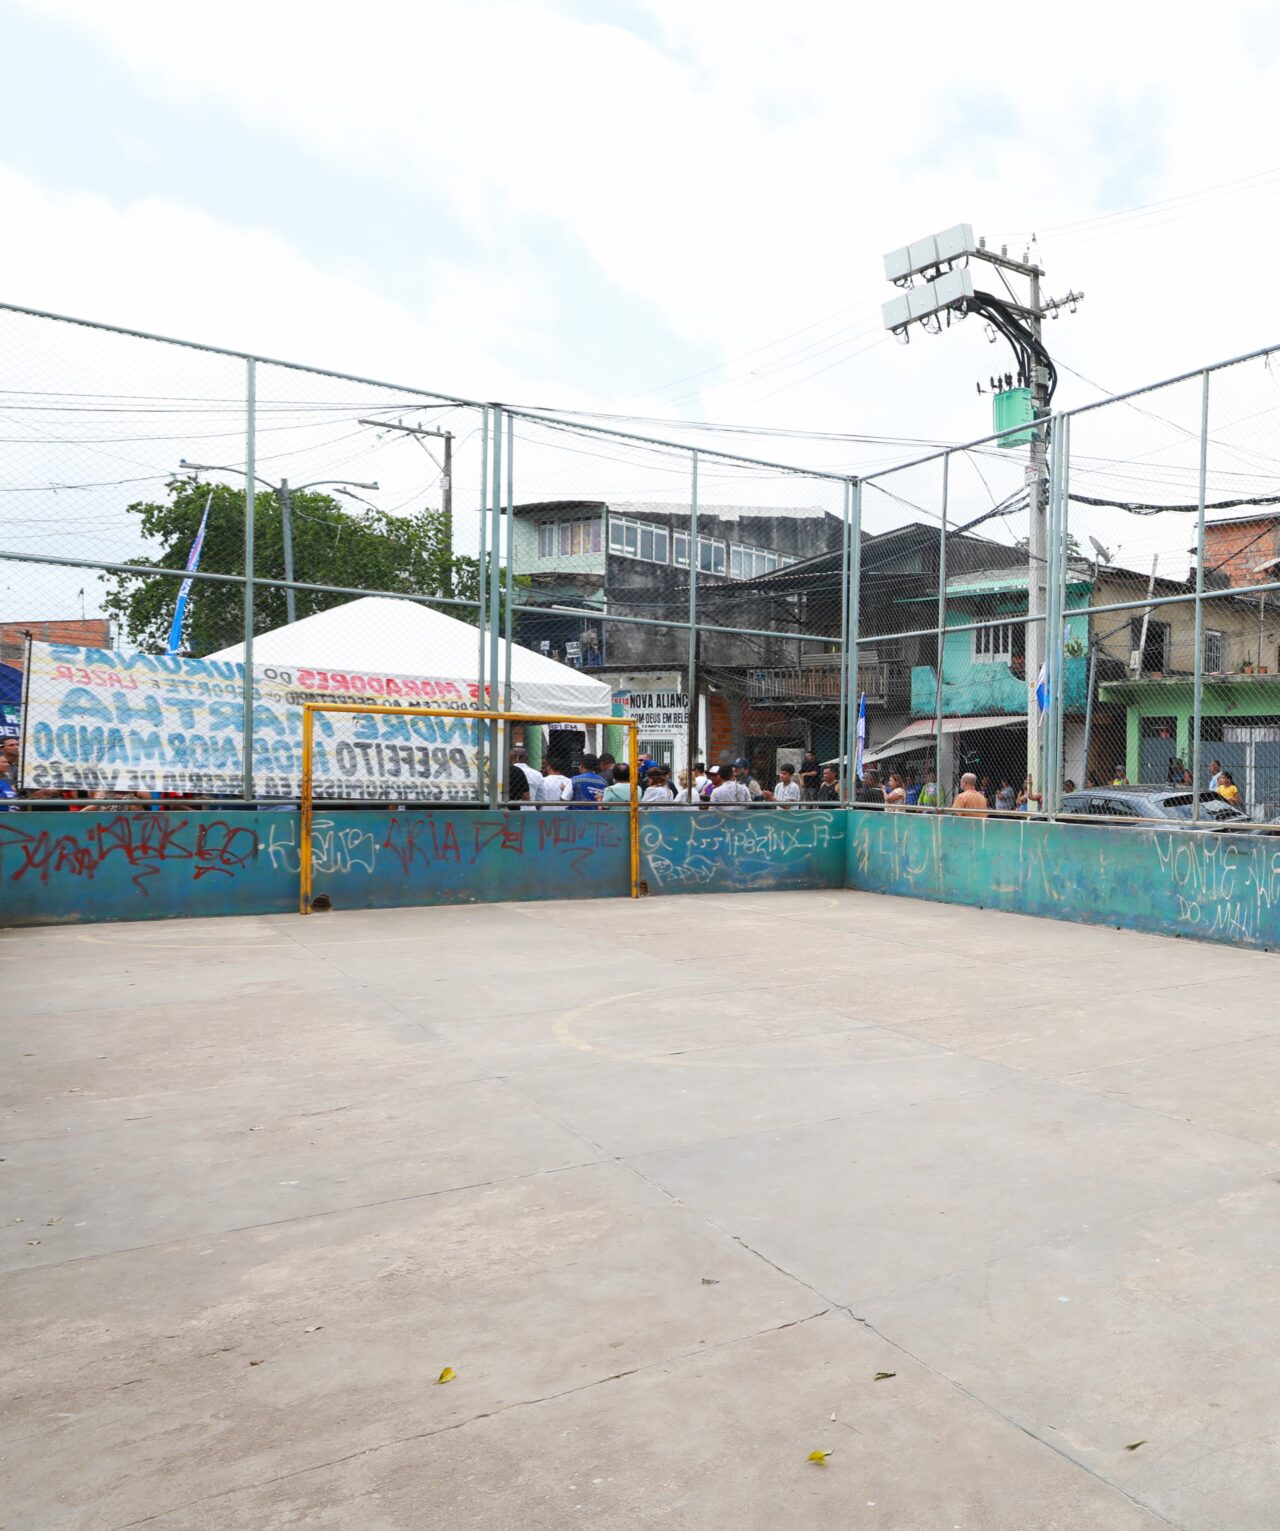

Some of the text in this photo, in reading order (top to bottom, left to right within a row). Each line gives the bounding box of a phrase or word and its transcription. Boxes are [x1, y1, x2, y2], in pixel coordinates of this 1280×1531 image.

[630, 693, 654, 709] NOVA
[656, 693, 689, 710] ALIANÇ
[645, 713, 661, 724] DEUS
[662, 713, 672, 724] EM
[673, 713, 689, 724] BELE
